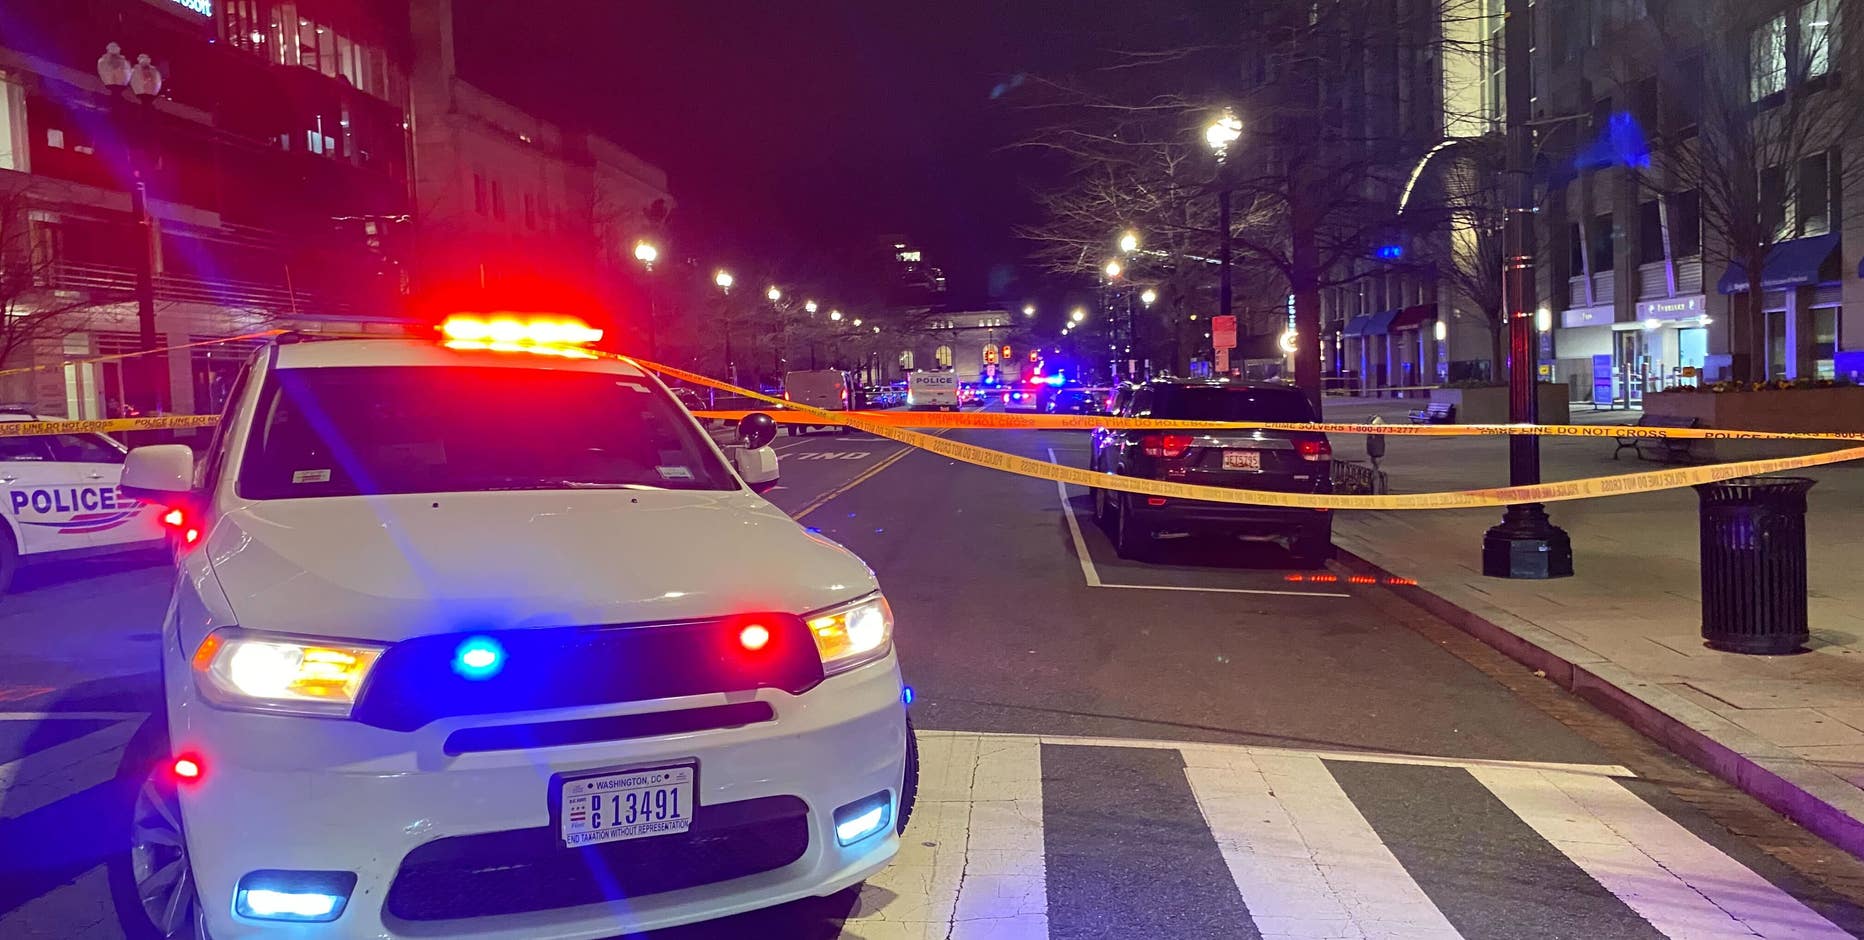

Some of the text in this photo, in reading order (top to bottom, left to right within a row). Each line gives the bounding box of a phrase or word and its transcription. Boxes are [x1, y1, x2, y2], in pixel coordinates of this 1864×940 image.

[916, 377, 953, 385] POLICE
[23, 423, 44, 431] LINE
[46, 422, 60, 430] DO
[62, 421, 80, 430] NOT
[82, 420, 114, 429] CROSS
[135, 417, 167, 426] POLICE
[169, 416, 190, 425] LINE
[192, 416, 206, 424] DO
[1299, 423, 1344, 431] SOLVERS
[1348, 425, 1419, 433] 1-800-673-2777
[1521, 426, 1552, 434] LINE
[1557, 427, 1578, 435] DO
[1583, 428, 1609, 436] NOT
[1616, 429, 1667, 438] CROSS
[10, 487, 116, 515] POLICE
[651, 774, 662, 784] DC
[611, 787, 681, 827] 13491
[567, 819, 689, 845] END TAXATION WITHOUT REPRESENTATION
